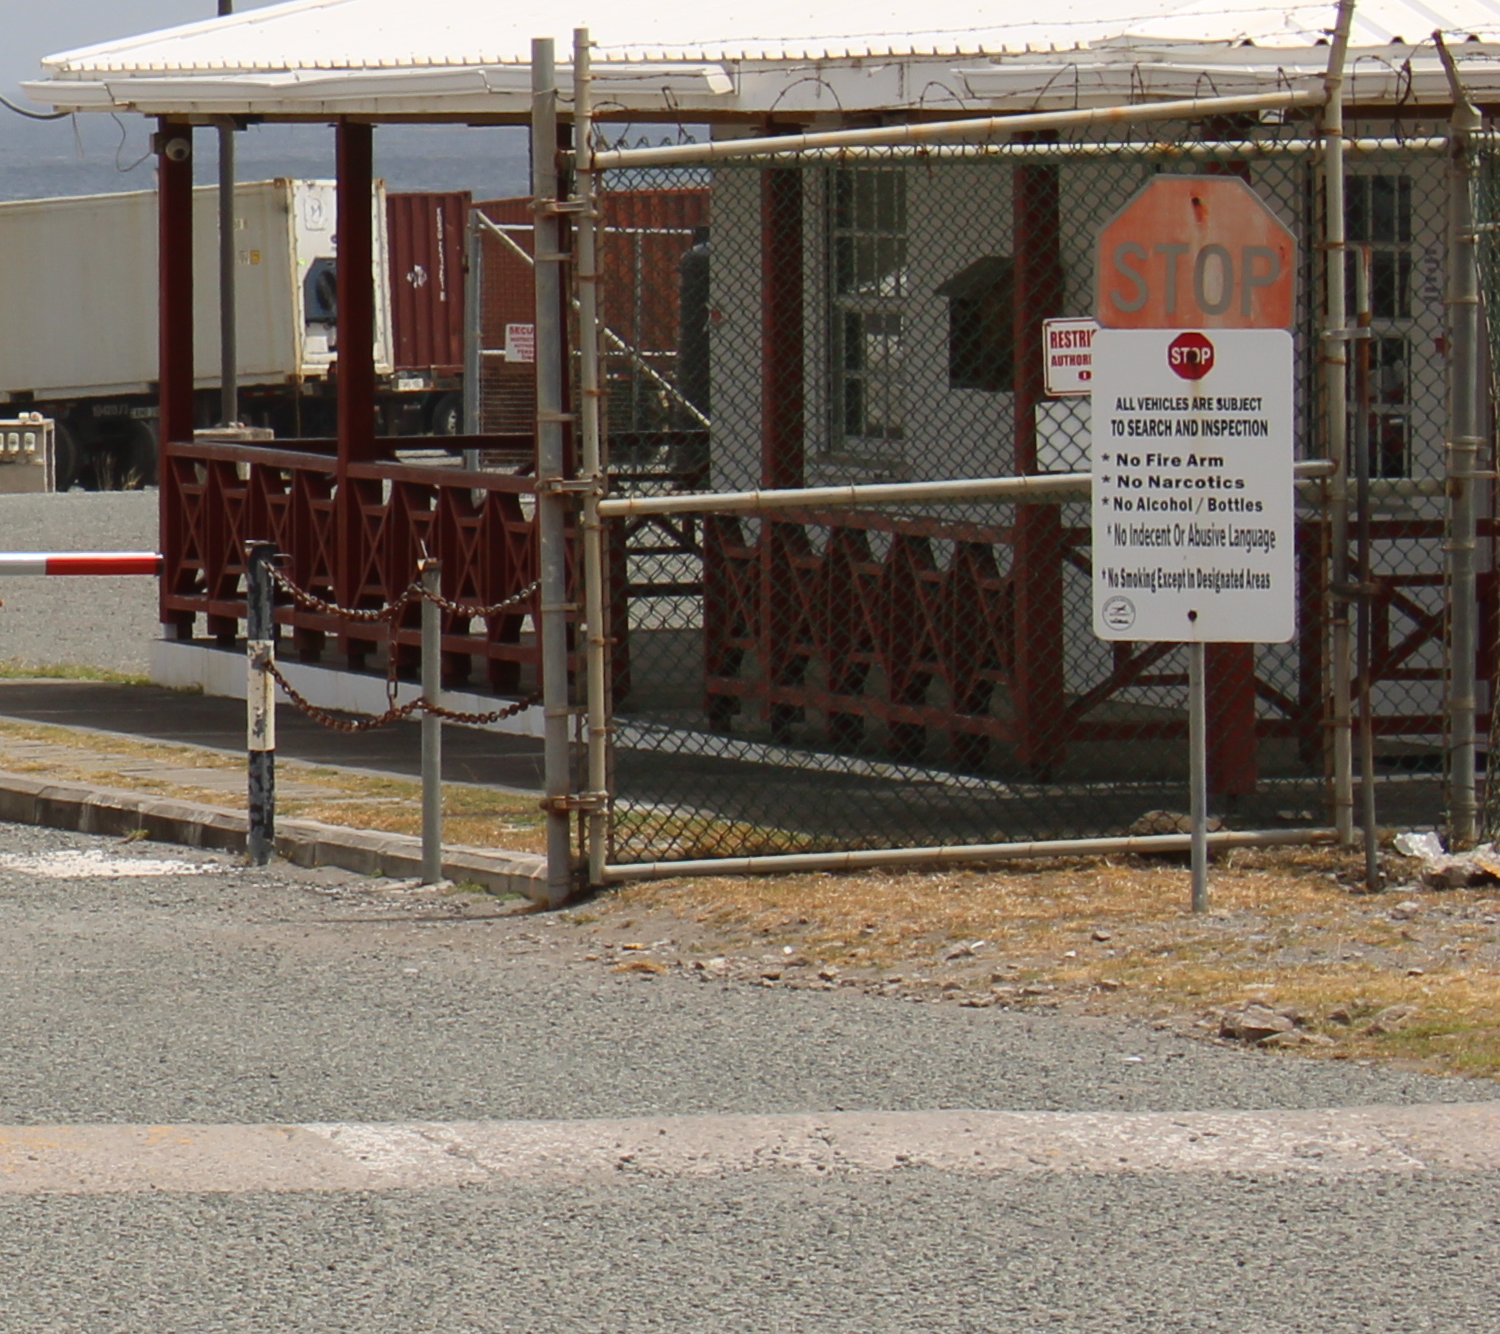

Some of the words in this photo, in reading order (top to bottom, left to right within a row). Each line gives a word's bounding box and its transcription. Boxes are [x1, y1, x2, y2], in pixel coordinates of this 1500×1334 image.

[1110, 240, 1281, 316] STOP
[1171, 347, 1211, 365] STOP
[1116, 397, 1135, 411] ALL
[1137, 397, 1189, 411] VEHICLES
[1191, 397, 1214, 411] ARE
[1216, 397, 1262, 411] SUBJECT
[1111, 419, 1125, 437] TO
[1127, 419, 1172, 437] SEARCH
[1175, 419, 1198, 437] AND
[1201, 419, 1268, 437] INSPECTION
[1116, 453, 1140, 467] No
[1146, 453, 1181, 467] Fire
[1186, 453, 1224, 467] Arm
[1117, 475, 1142, 489] No
[1148, 475, 1245, 489] Narcotics
[1113, 496, 1132, 512] No
[1137, 496, 1192, 512] Alcohol
[1208, 497, 1263, 512] Bottles
[1114, 523, 1127, 547] No
[1130, 522, 1171, 547] Indecent
[1174, 523, 1185, 547] Or
[1188, 522, 1226, 548] Abusive
[1229, 524, 1276, 554] Language
[1108, 568, 1120, 589] No
[1120, 567, 1156, 594] Smoking
[1157, 568, 1187, 592] Except
[1187, 568, 1195, 589] In
[1197, 567, 1244, 594] Designated
[1246, 568, 1270, 589] Areas
